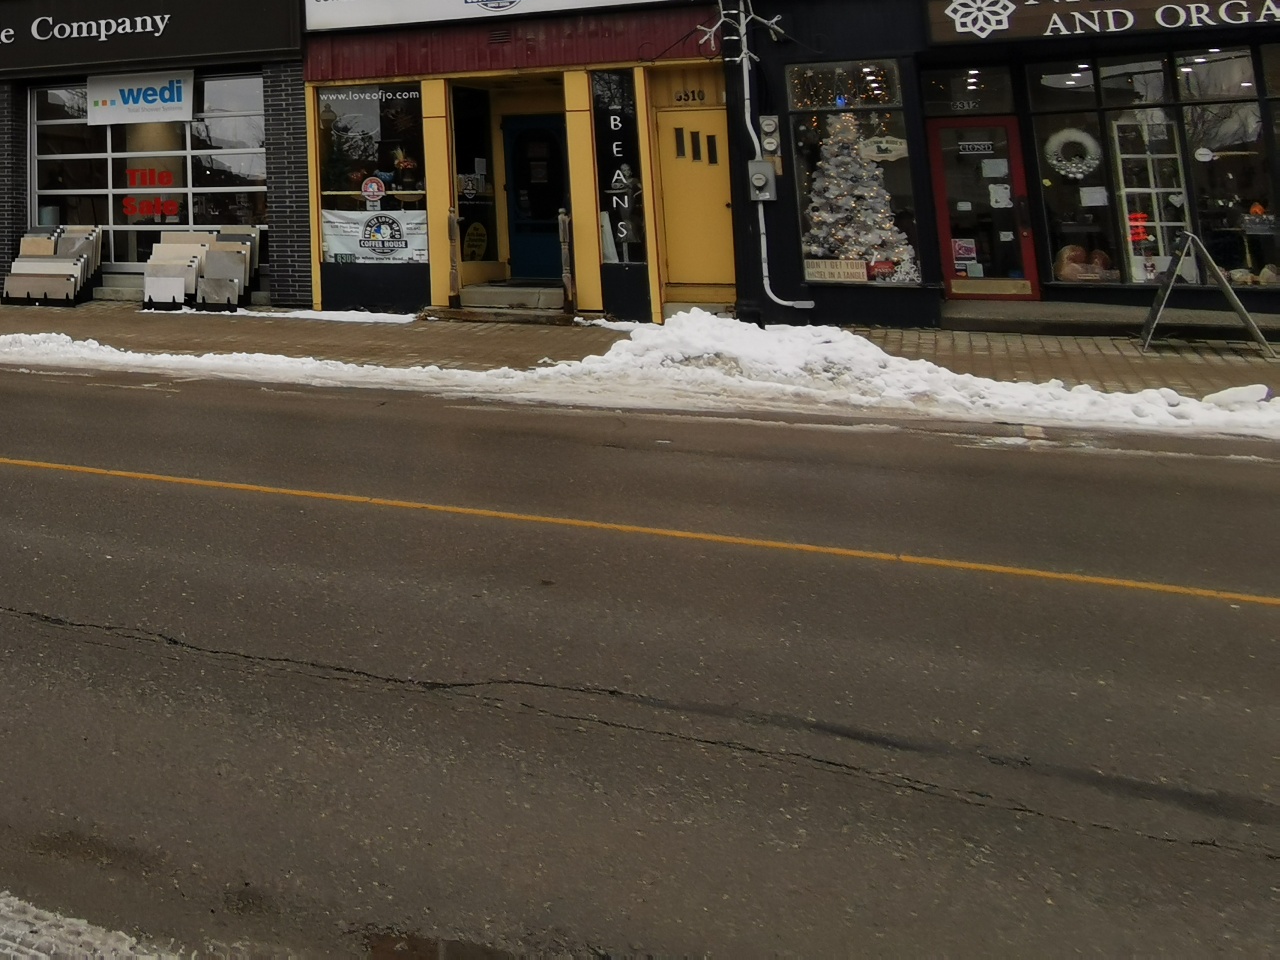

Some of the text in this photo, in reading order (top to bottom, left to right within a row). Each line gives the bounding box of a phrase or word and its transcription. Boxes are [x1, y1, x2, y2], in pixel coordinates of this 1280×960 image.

[30, 14, 171, 42] Company
[1043, 8, 1134, 36] AND
[119, 79, 183, 105] wedi
[320, 90, 419, 102] www.loveofjo.com
[959, 144, 992, 152] CLOSED
[126, 168, 174, 188] Tile
[122, 197, 179, 216] Sale
[384, 240, 406, 248] HOUSE
